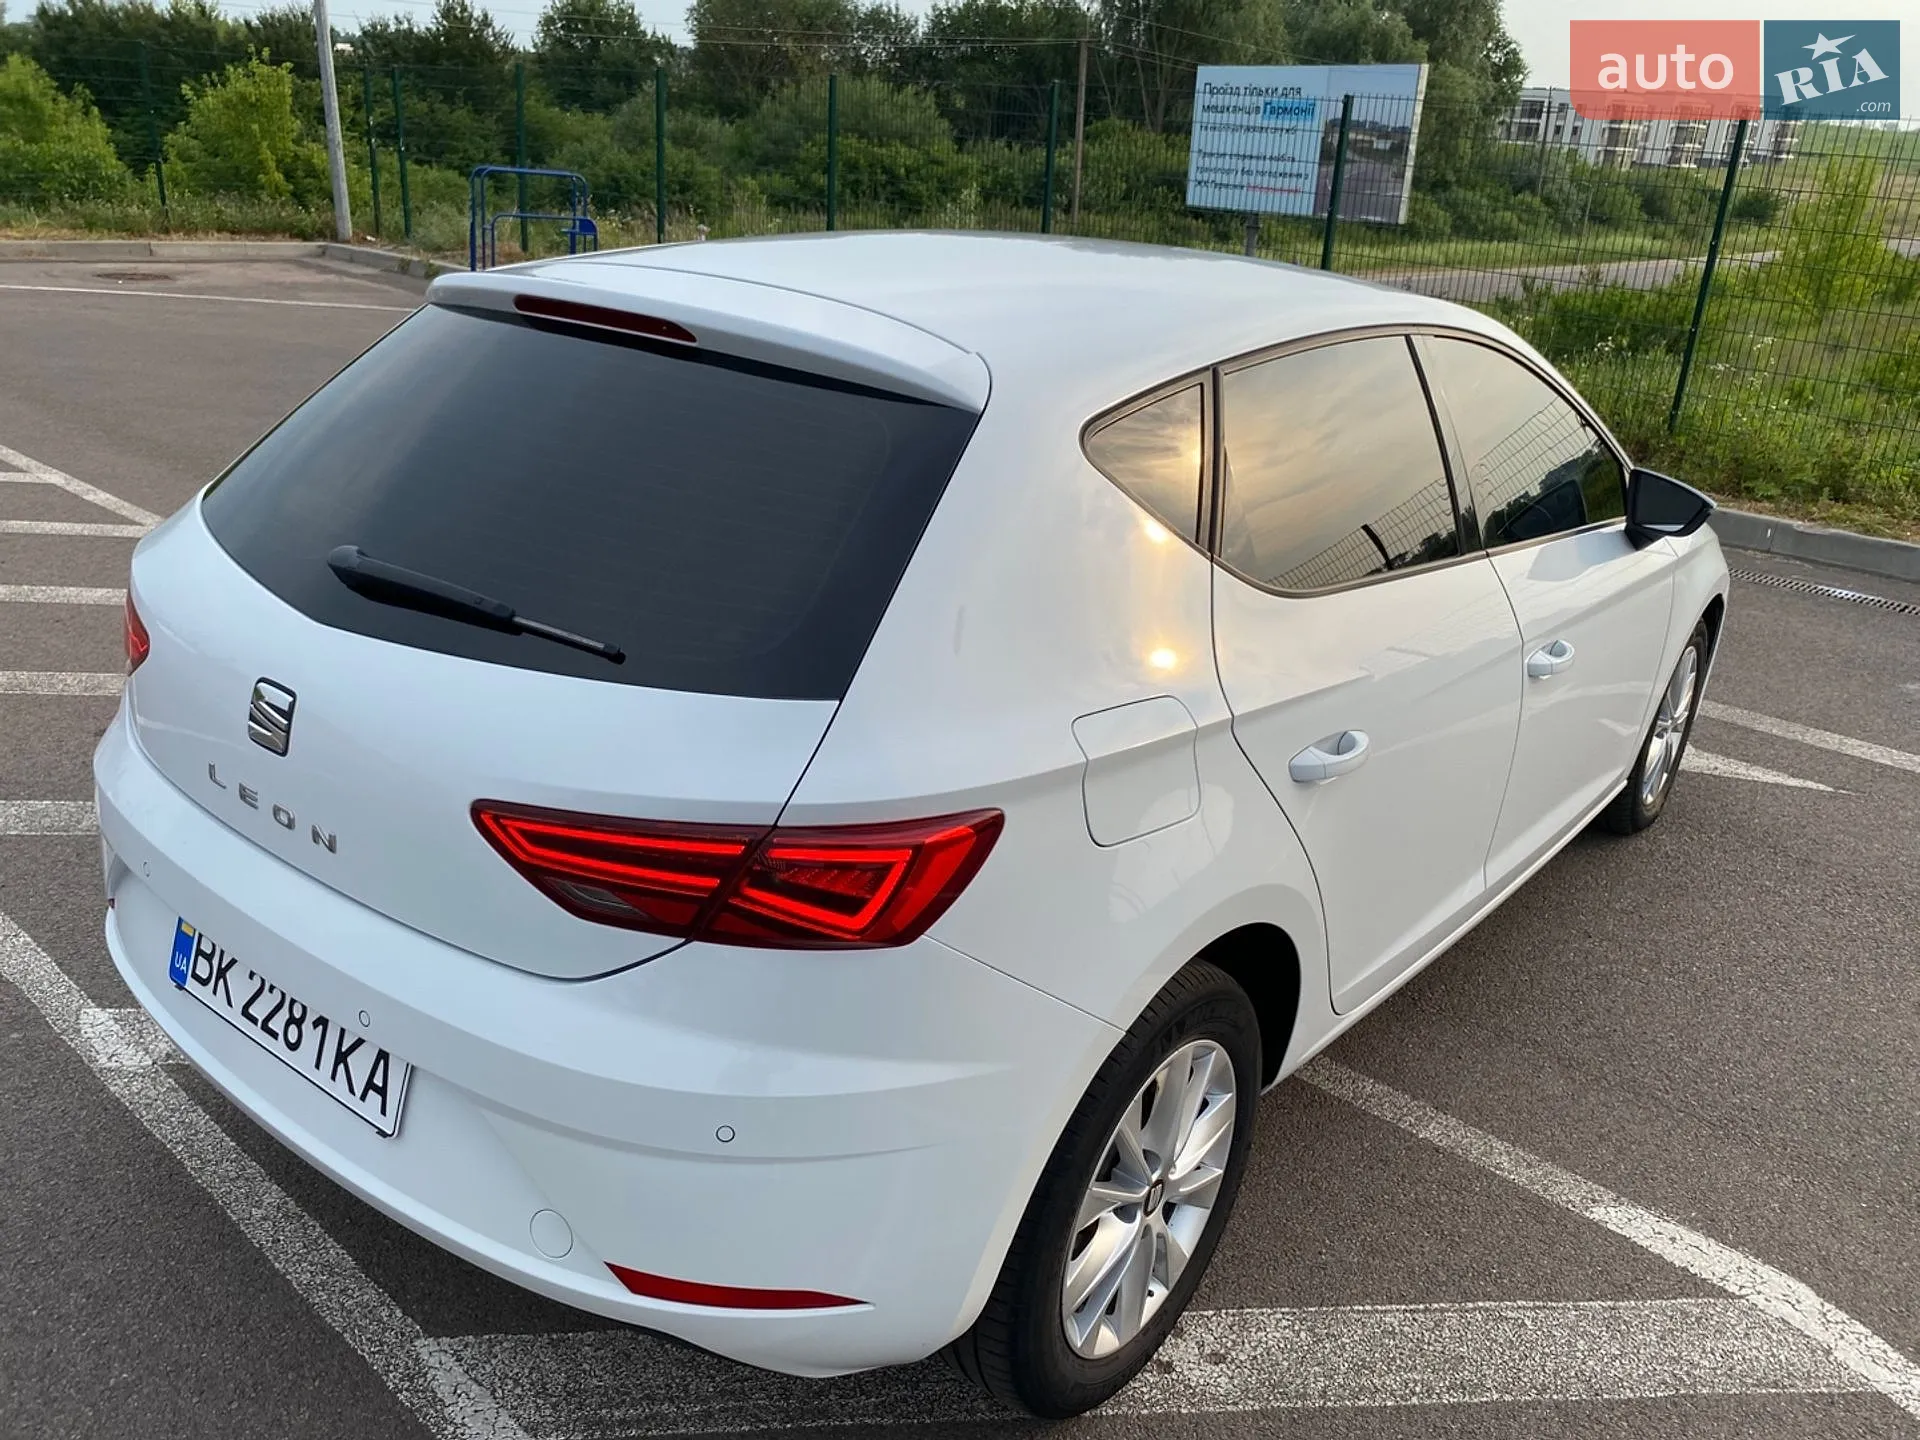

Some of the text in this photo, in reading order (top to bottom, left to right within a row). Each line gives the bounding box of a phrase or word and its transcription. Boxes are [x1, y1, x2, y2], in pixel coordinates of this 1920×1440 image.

[1203, 82, 1302, 98] Проїзд тільки для
[1201, 102, 1316, 119] мешканців Гармонії
[208, 760, 338, 854] LEON
[174, 951, 188, 975] UA
[190, 931, 239, 1009] BK
